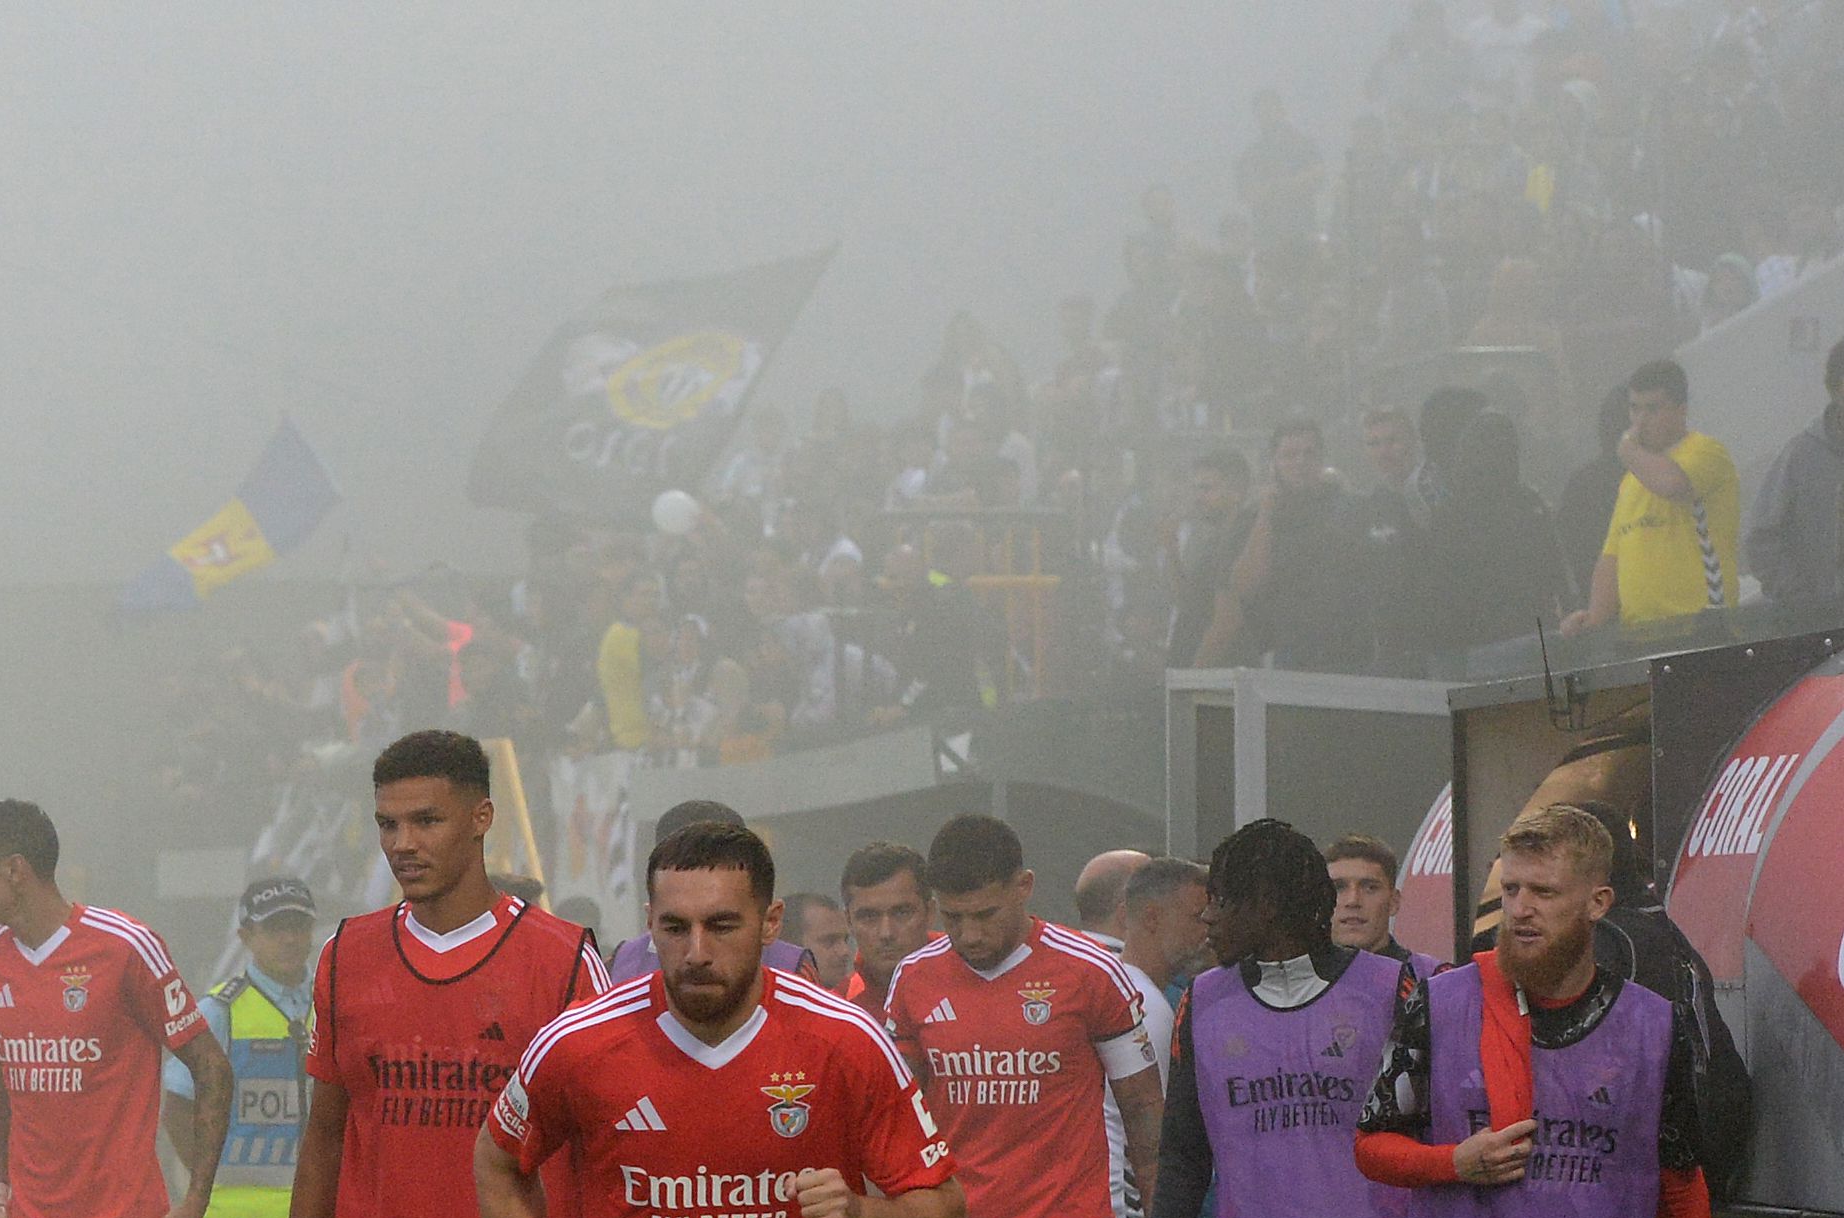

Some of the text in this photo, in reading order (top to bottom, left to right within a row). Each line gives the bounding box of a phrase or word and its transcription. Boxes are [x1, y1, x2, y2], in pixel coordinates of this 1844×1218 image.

[1688, 753, 1800, 857] CORAL
[8, 1067, 83, 1093] FLY BETTER
[927, 1043, 1061, 1077] Emirates
[947, 1079, 1040, 1105] FLY BETTER
[1227, 1067, 1355, 1108] Emirates
[1467, 1109, 1620, 1154] Eirates
[619, 1164, 817, 1210] Emirate
